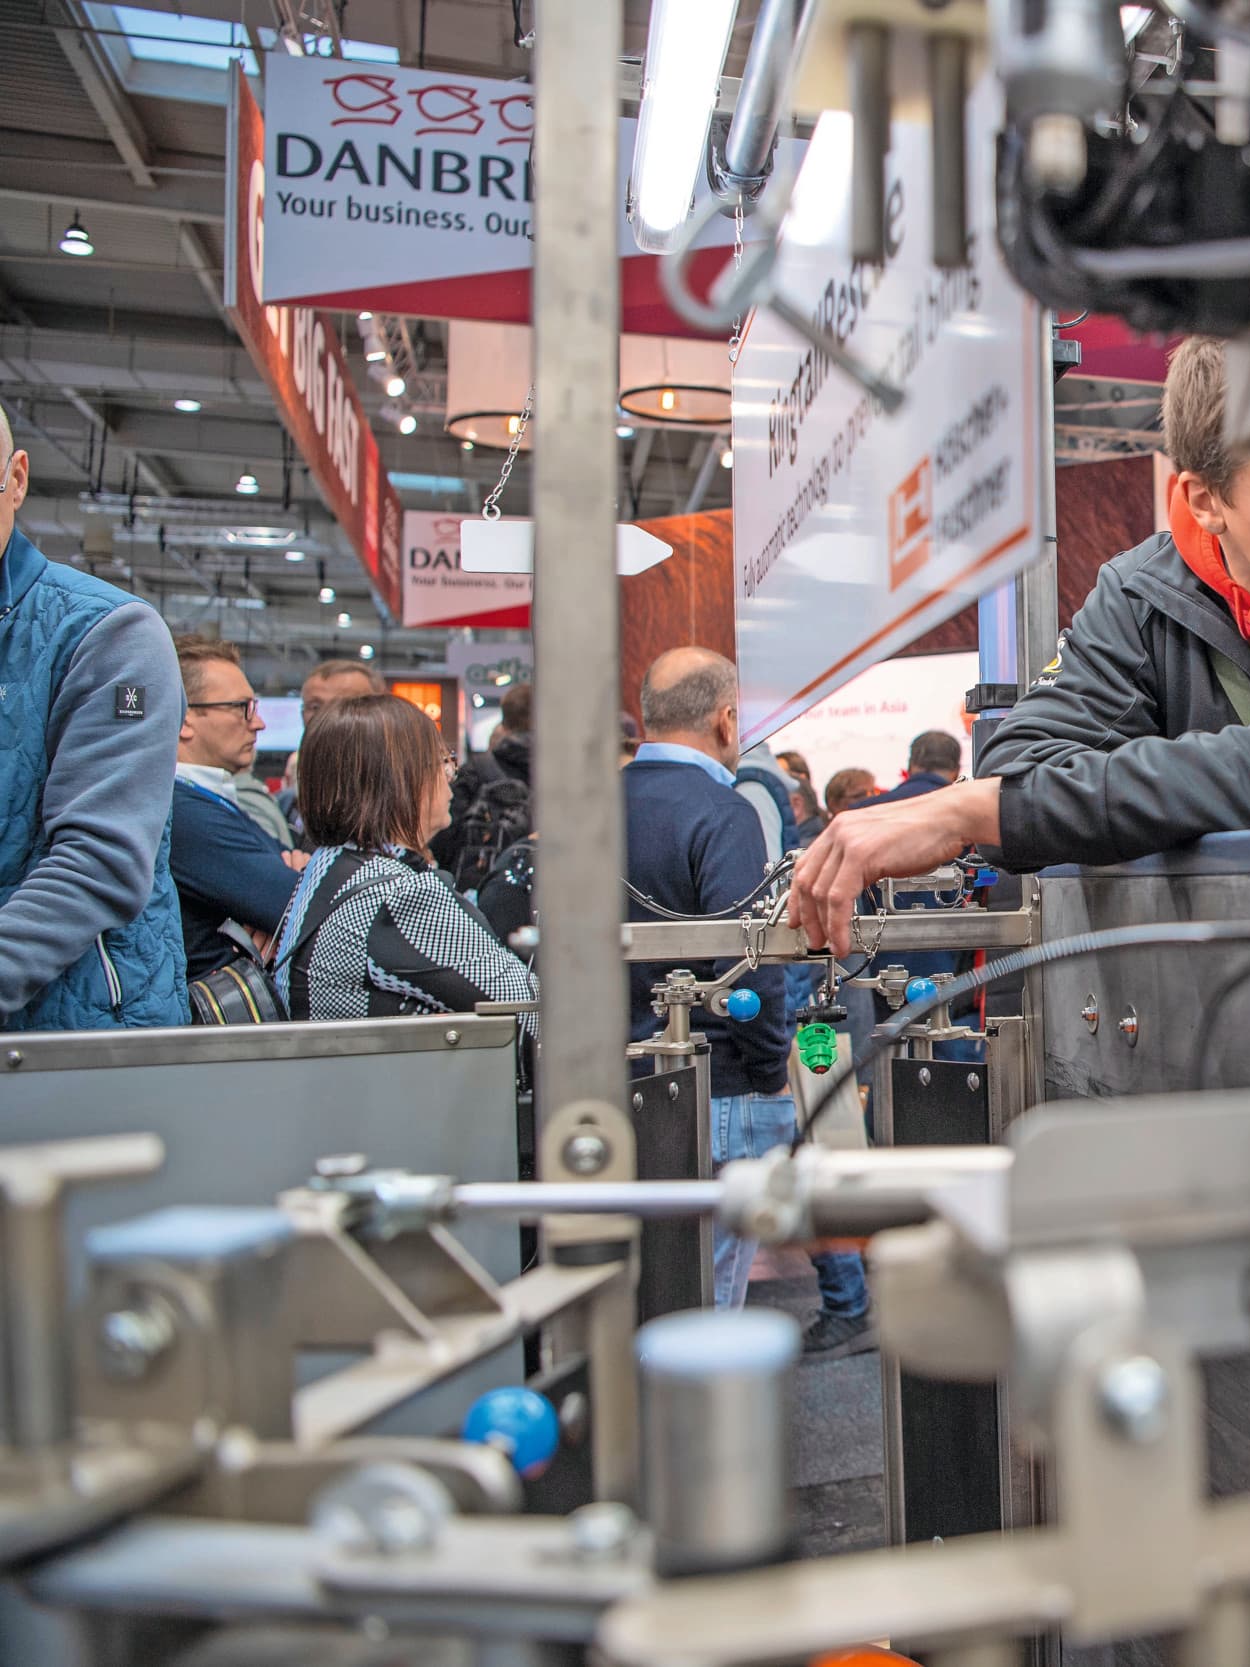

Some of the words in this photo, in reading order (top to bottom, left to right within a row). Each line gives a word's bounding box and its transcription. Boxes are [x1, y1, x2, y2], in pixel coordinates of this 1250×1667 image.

[276, 191, 337, 217] Your
[346, 196, 474, 232] business.
[485, 212, 531, 237] Our
